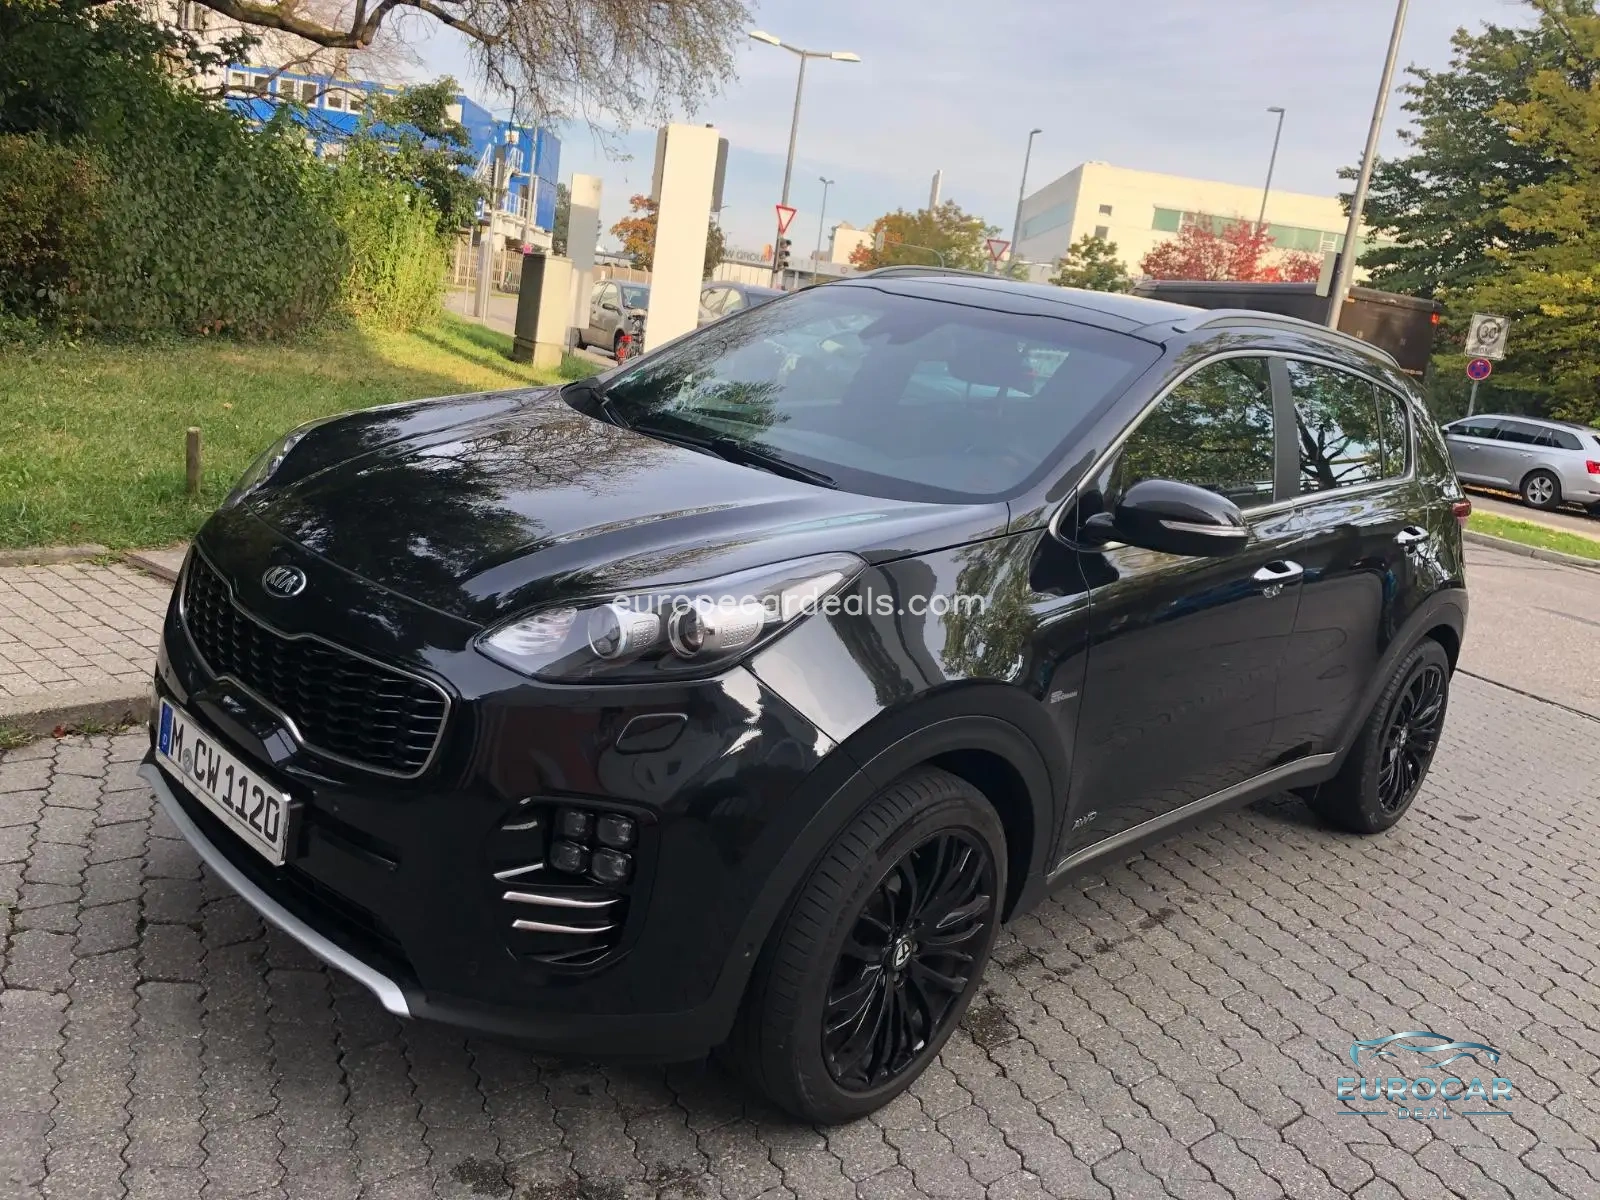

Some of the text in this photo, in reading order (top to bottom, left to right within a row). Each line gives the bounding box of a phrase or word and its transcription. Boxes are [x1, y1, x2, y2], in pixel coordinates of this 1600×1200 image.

[1481, 325, 1496, 339] 30
[267, 567, 298, 593] KIA
[171, 716, 280, 843] M CW 1120
